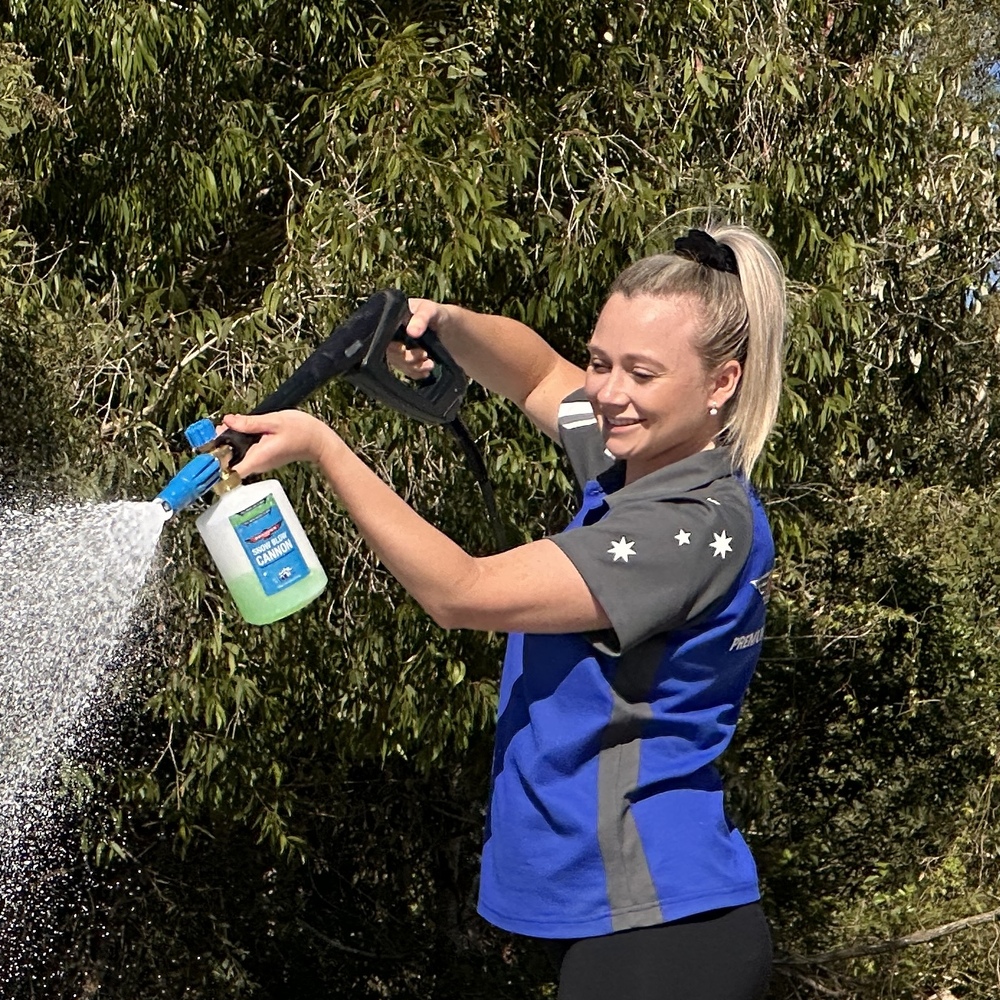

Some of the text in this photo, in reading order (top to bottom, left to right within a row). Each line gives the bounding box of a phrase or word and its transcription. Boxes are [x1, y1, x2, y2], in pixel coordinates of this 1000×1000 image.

[252, 541, 272, 555] SNOW
[270, 531, 288, 546] BLOW
[255, 538, 293, 566] CANNON
